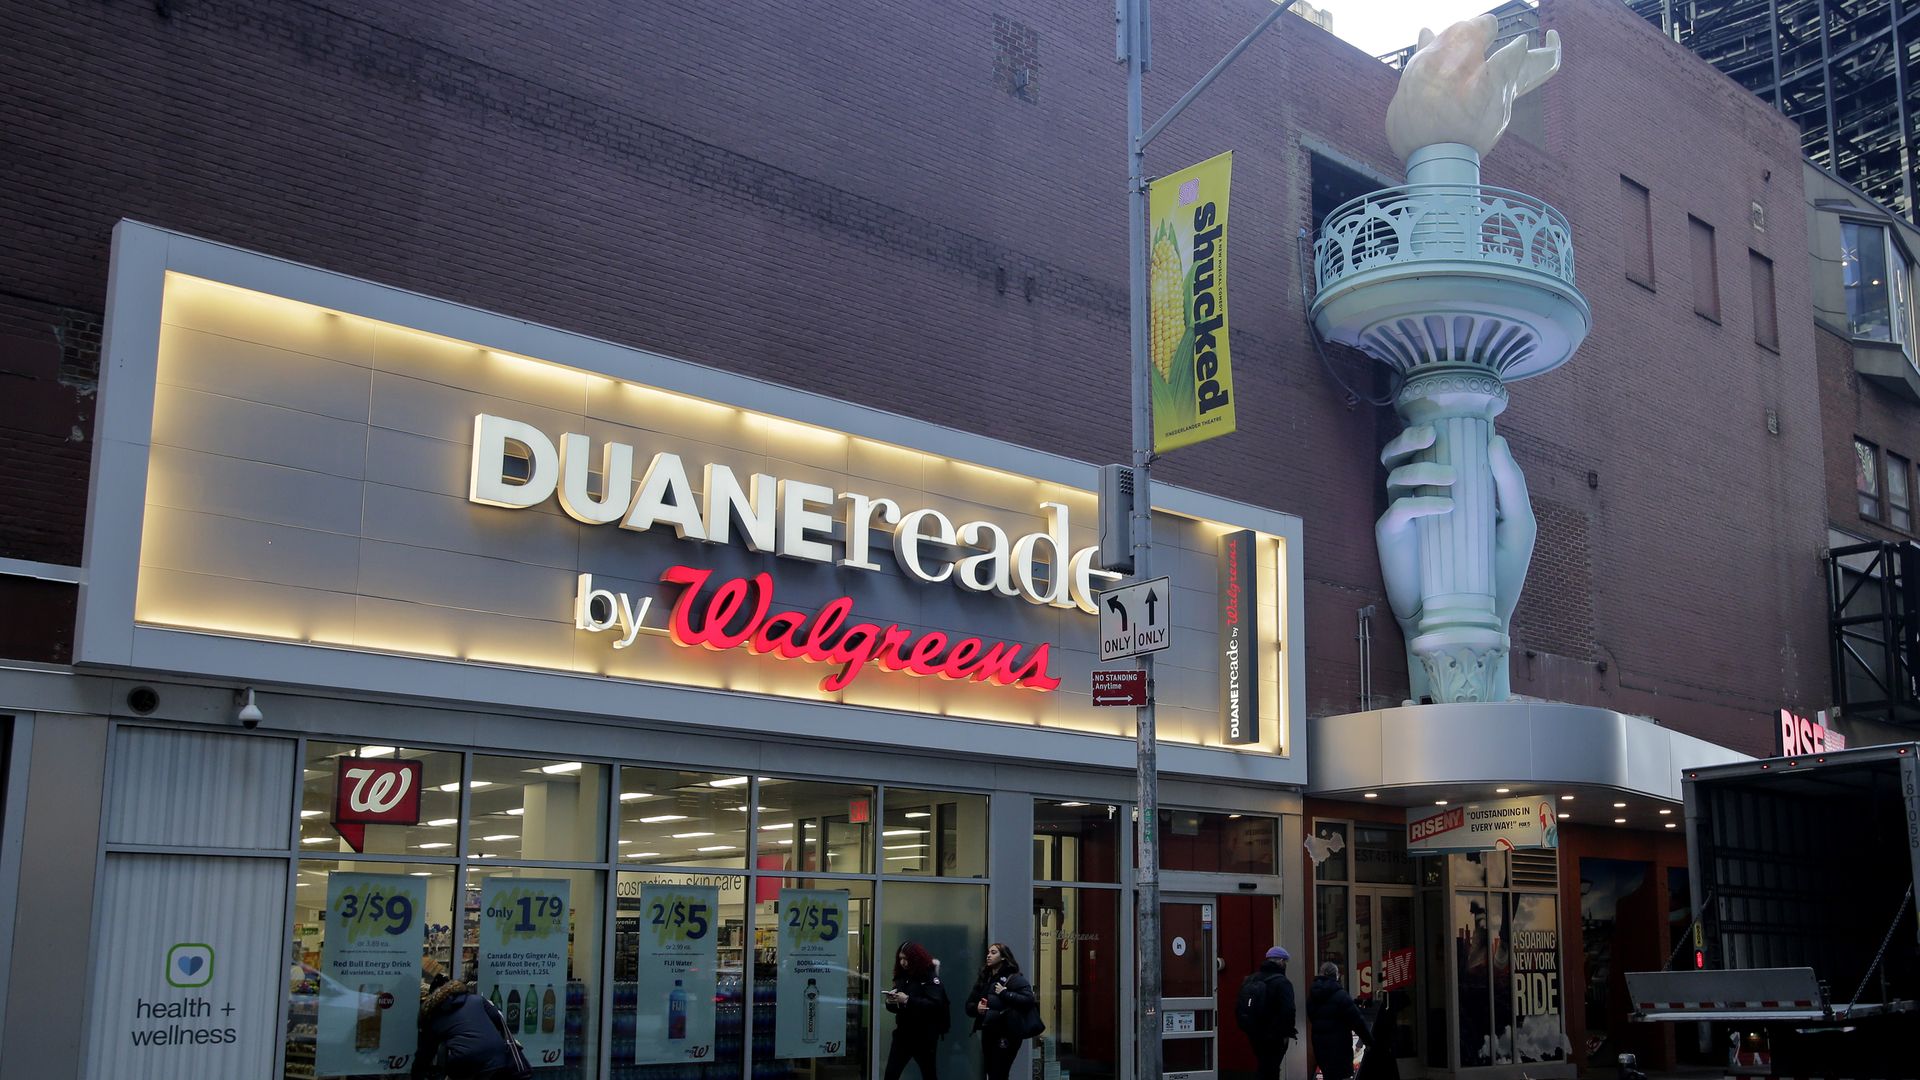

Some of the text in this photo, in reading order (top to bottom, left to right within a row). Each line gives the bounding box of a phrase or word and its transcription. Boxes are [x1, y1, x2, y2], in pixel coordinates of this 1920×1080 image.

[1193, 202, 1229, 415] shucked
[1226, 539, 1241, 627] Walgreens
[574, 564, 1062, 693] by Walgreens
[1231, 627, 1239, 637] by
[1104, 628, 1165, 653] ONLY ONLY
[1094, 673, 1138, 682] NO STANDING
[1095, 682, 1122, 691] Anytime
[345, 767, 412, 813] W
[1521, 807, 1530, 816] IN
[1471, 823, 1493, 833] EVERY
[341, 892, 413, 935] 3/$9
[486, 907, 513, 920] Only
[652, 901, 708, 940] 2/$5
[789, 905, 839, 942] 2/$5
[1519, 931, 1556, 949] SOARING
[365, 960, 390, 969] Energy
[391, 960, 411, 968] Drink
[487, 952, 560, 961] Canada Dry Ginger Ale,
[490, 960, 506, 968] A&W
[547, 961, 556, 969] Up
[1513, 951, 1556, 970] NEW YORK
[1514, 972, 1558, 1016] RIDE
[136, 997, 236, 1019] health +
[131, 1024, 237, 1047] wellness
